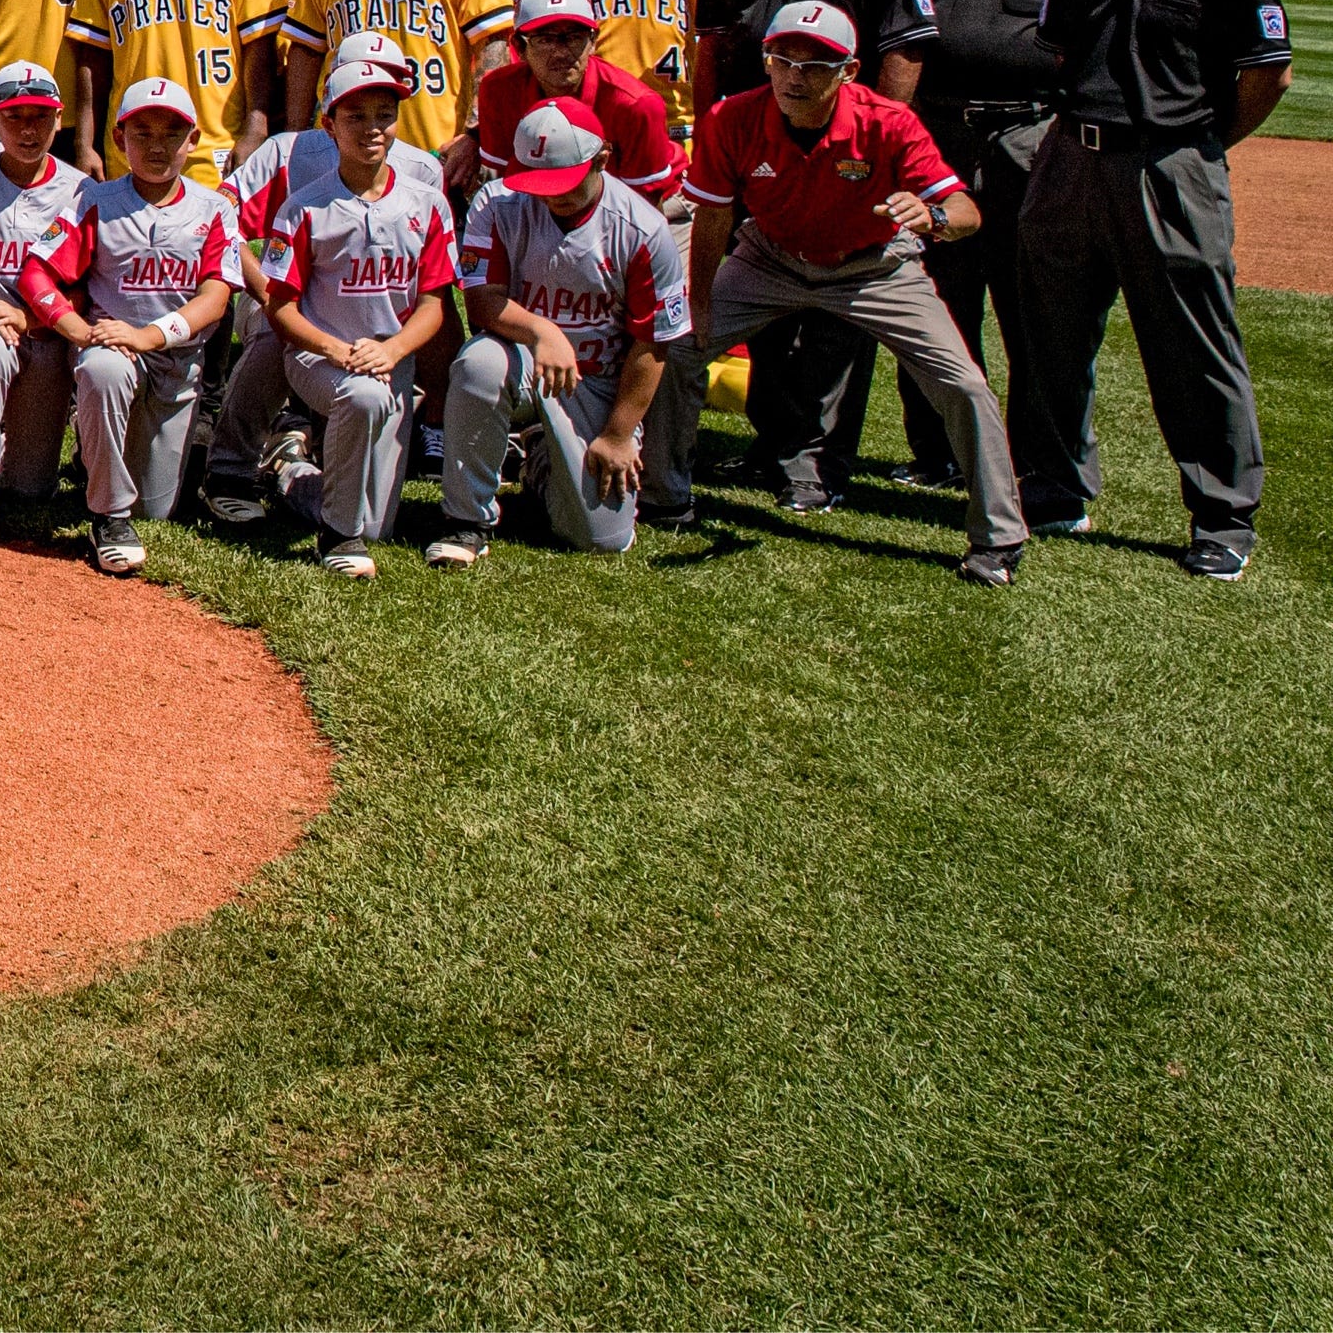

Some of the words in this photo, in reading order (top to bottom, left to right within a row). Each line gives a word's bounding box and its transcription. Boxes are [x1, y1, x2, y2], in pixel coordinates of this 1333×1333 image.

[803, 7, 824, 25] J
[370, 37, 383, 53] J
[197, 48, 232, 86] 15
[361, 64, 374, 78] J
[152, 81, 167, 96] J
[531, 136, 547, 157] J
[342, 257, 419, 288] JAPAN
